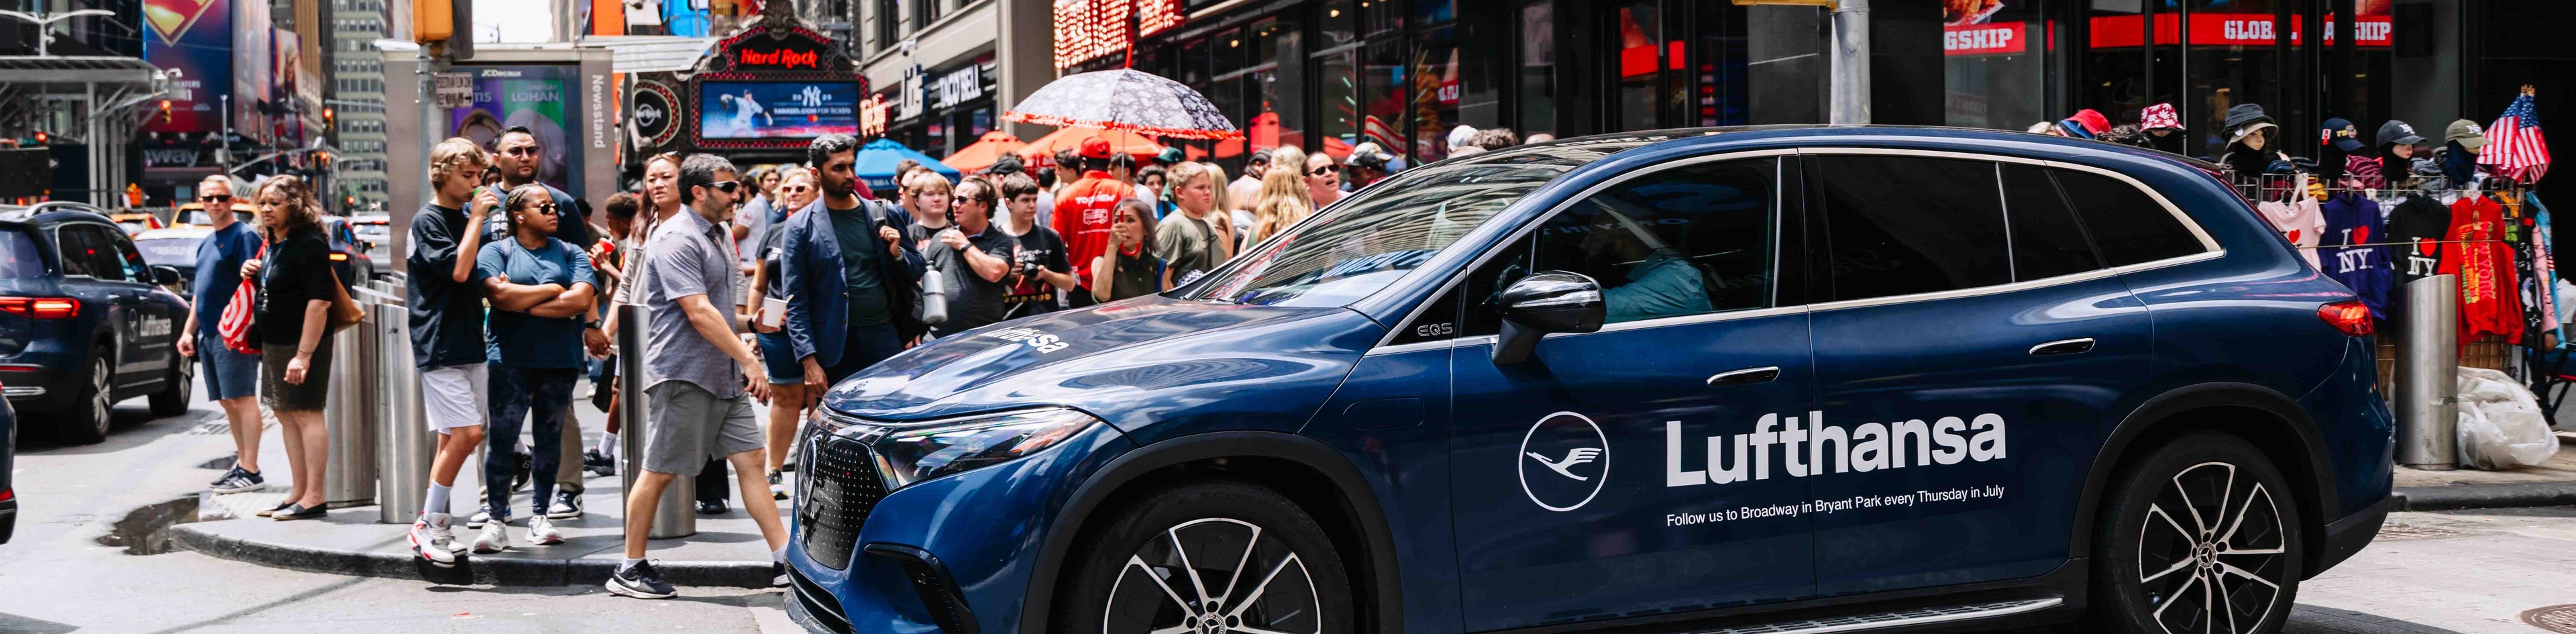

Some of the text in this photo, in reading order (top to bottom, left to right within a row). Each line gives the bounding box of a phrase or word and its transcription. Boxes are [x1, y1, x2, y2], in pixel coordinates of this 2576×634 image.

[741, 48, 818, 69] Hard Rock
[481, 69, 522, 77] JCDecaux
[938, 64, 982, 108] TACO BELL
[511, 91, 559, 102] LOHAN
[592, 74, 606, 148] Newsstand
[2337, 248, 2373, 274] NY
[2407, 256, 2436, 276] NY
[2478, 259, 2493, 299] YORK
[1417, 322, 1453, 337] EQS
[1666, 410, 2006, 487] Lufthansa
[1666, 484, 2004, 527] Follow us to Broadway in Bryant Park every Thursday in July
